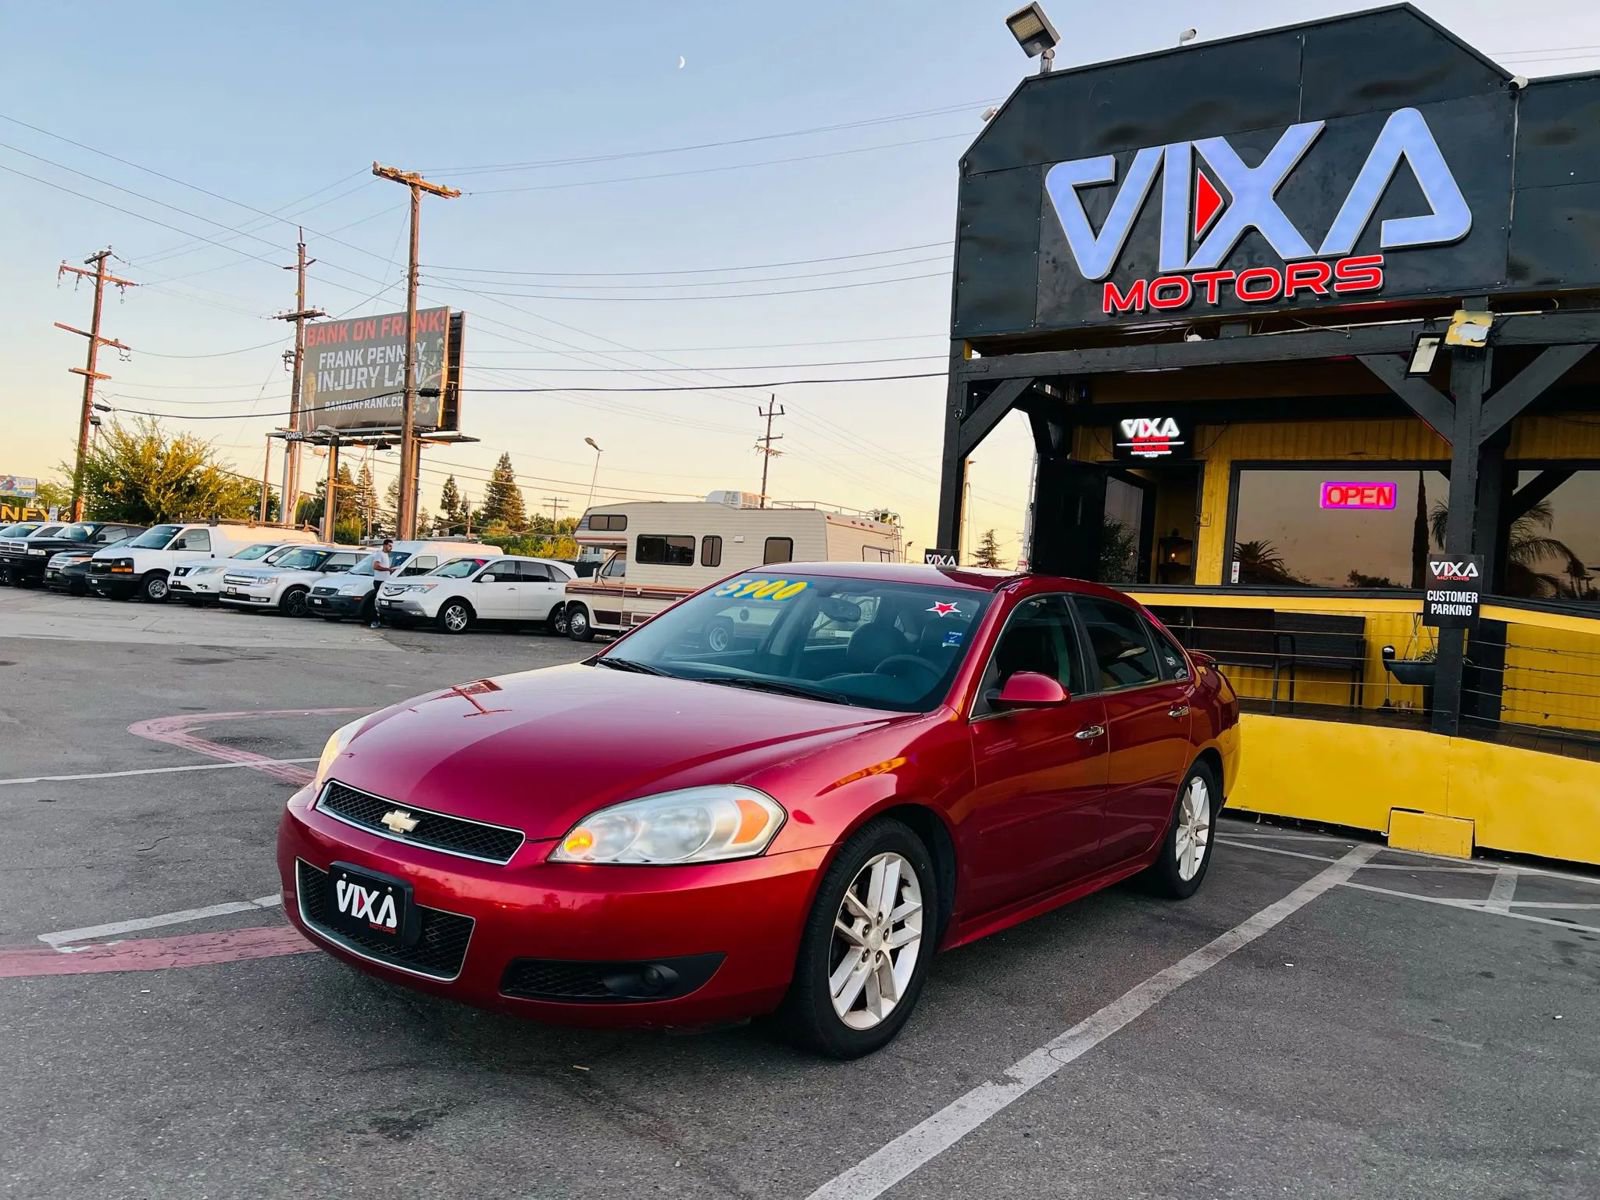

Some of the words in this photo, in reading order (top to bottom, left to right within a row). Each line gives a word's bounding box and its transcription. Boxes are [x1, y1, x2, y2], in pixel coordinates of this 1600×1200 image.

[1044, 107, 1472, 281] VIXA
[1102, 254, 1385, 314] MOTORS
[306, 322, 349, 346] BANK
[352, 319, 377, 341] ON
[319, 348, 364, 369] FRANK
[317, 366, 381, 393] INJURY
[1120, 417, 1180, 439] VIXA
[1327, 485, 1393, 506] OPEN
[925, 554, 957, 566] VIXA
[1429, 561, 1479, 577] VIXA
[715, 579, 808, 601] 5900
[1426, 590, 1479, 603] CUSTOMER
[1430, 603, 1473, 616] PARKING
[336, 879, 398, 929] VIXA
